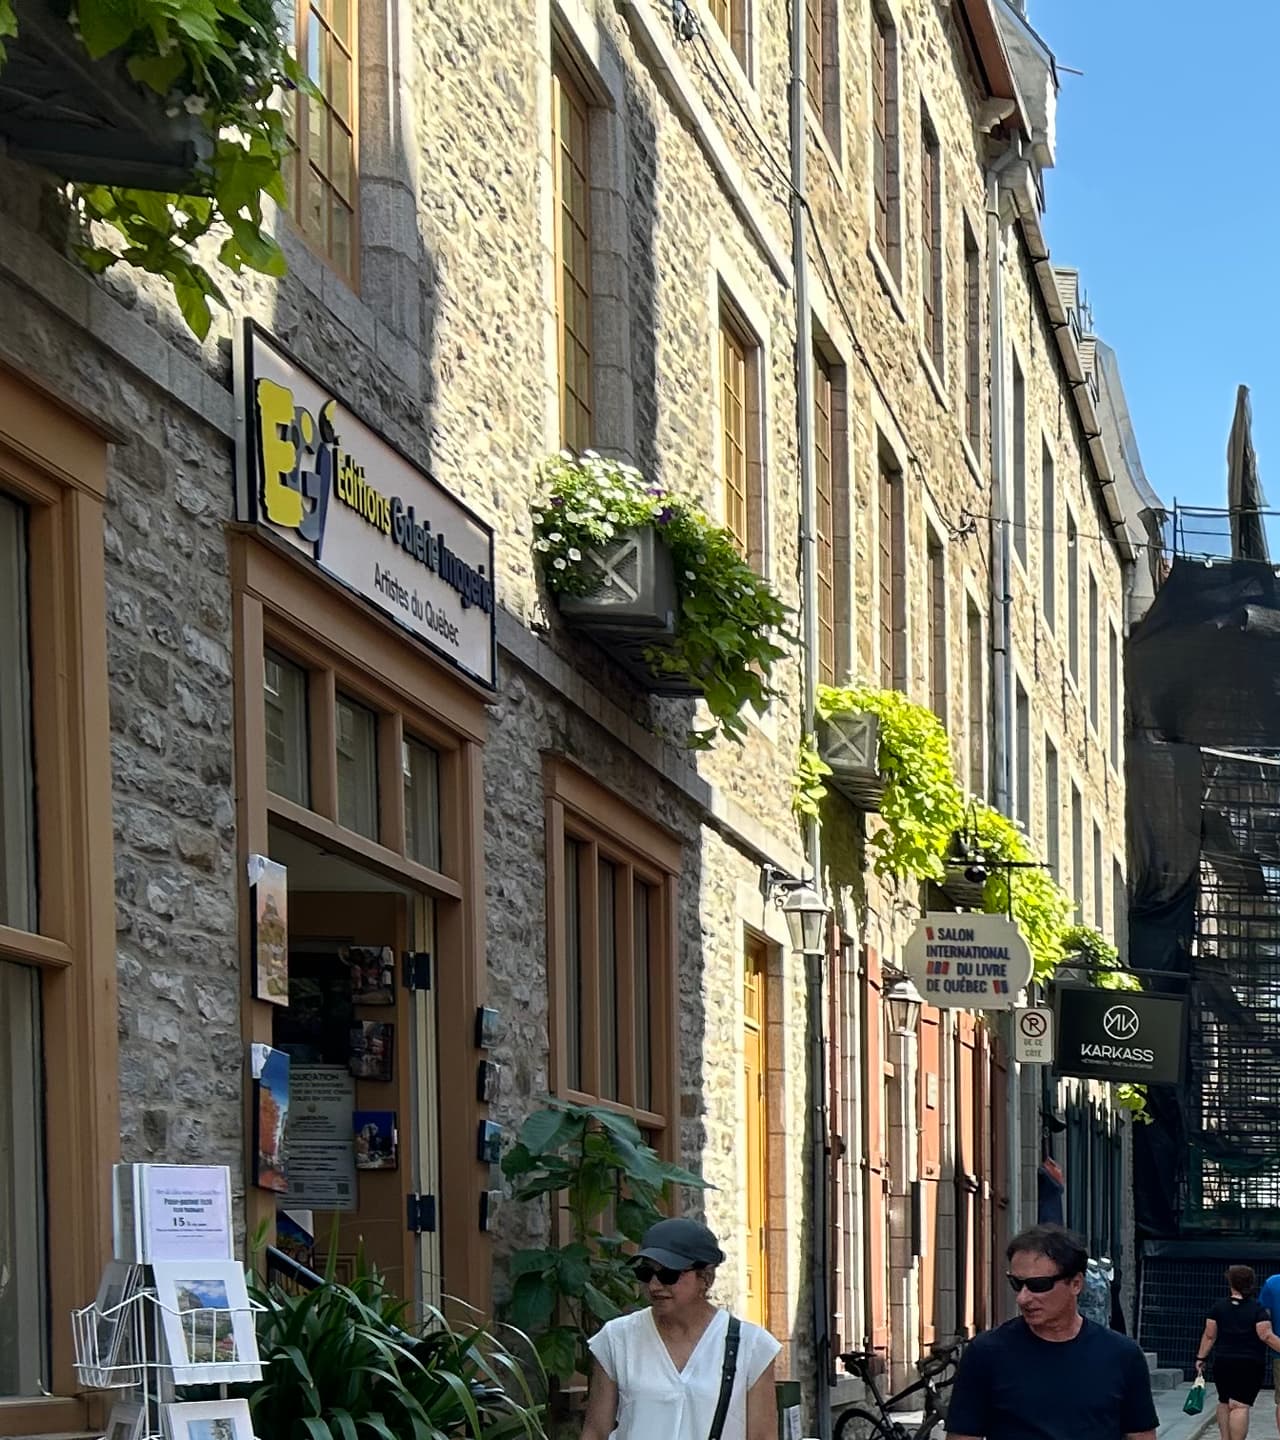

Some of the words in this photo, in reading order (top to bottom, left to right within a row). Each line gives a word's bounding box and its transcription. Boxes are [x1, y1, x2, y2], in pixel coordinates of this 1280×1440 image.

[390, 496, 440, 573] Galerie
[438, 533, 493, 614] Imagerie
[373, 562, 409, 611] Artistes
[411, 589, 424, 621] du
[425, 599, 460, 646] Québec
[937, 927, 975, 942] SALON
[926, 945, 1010, 960] INTERNATIONAL
[956, 961, 974, 976] DU
[975, 962, 1007, 977] LIVRE
[926, 979, 941, 993] DE
[943, 976, 988, 994] QUÉBEC
[1081, 1043, 1154, 1062] KARKASS
[173, 1217, 185, 1227] 15
